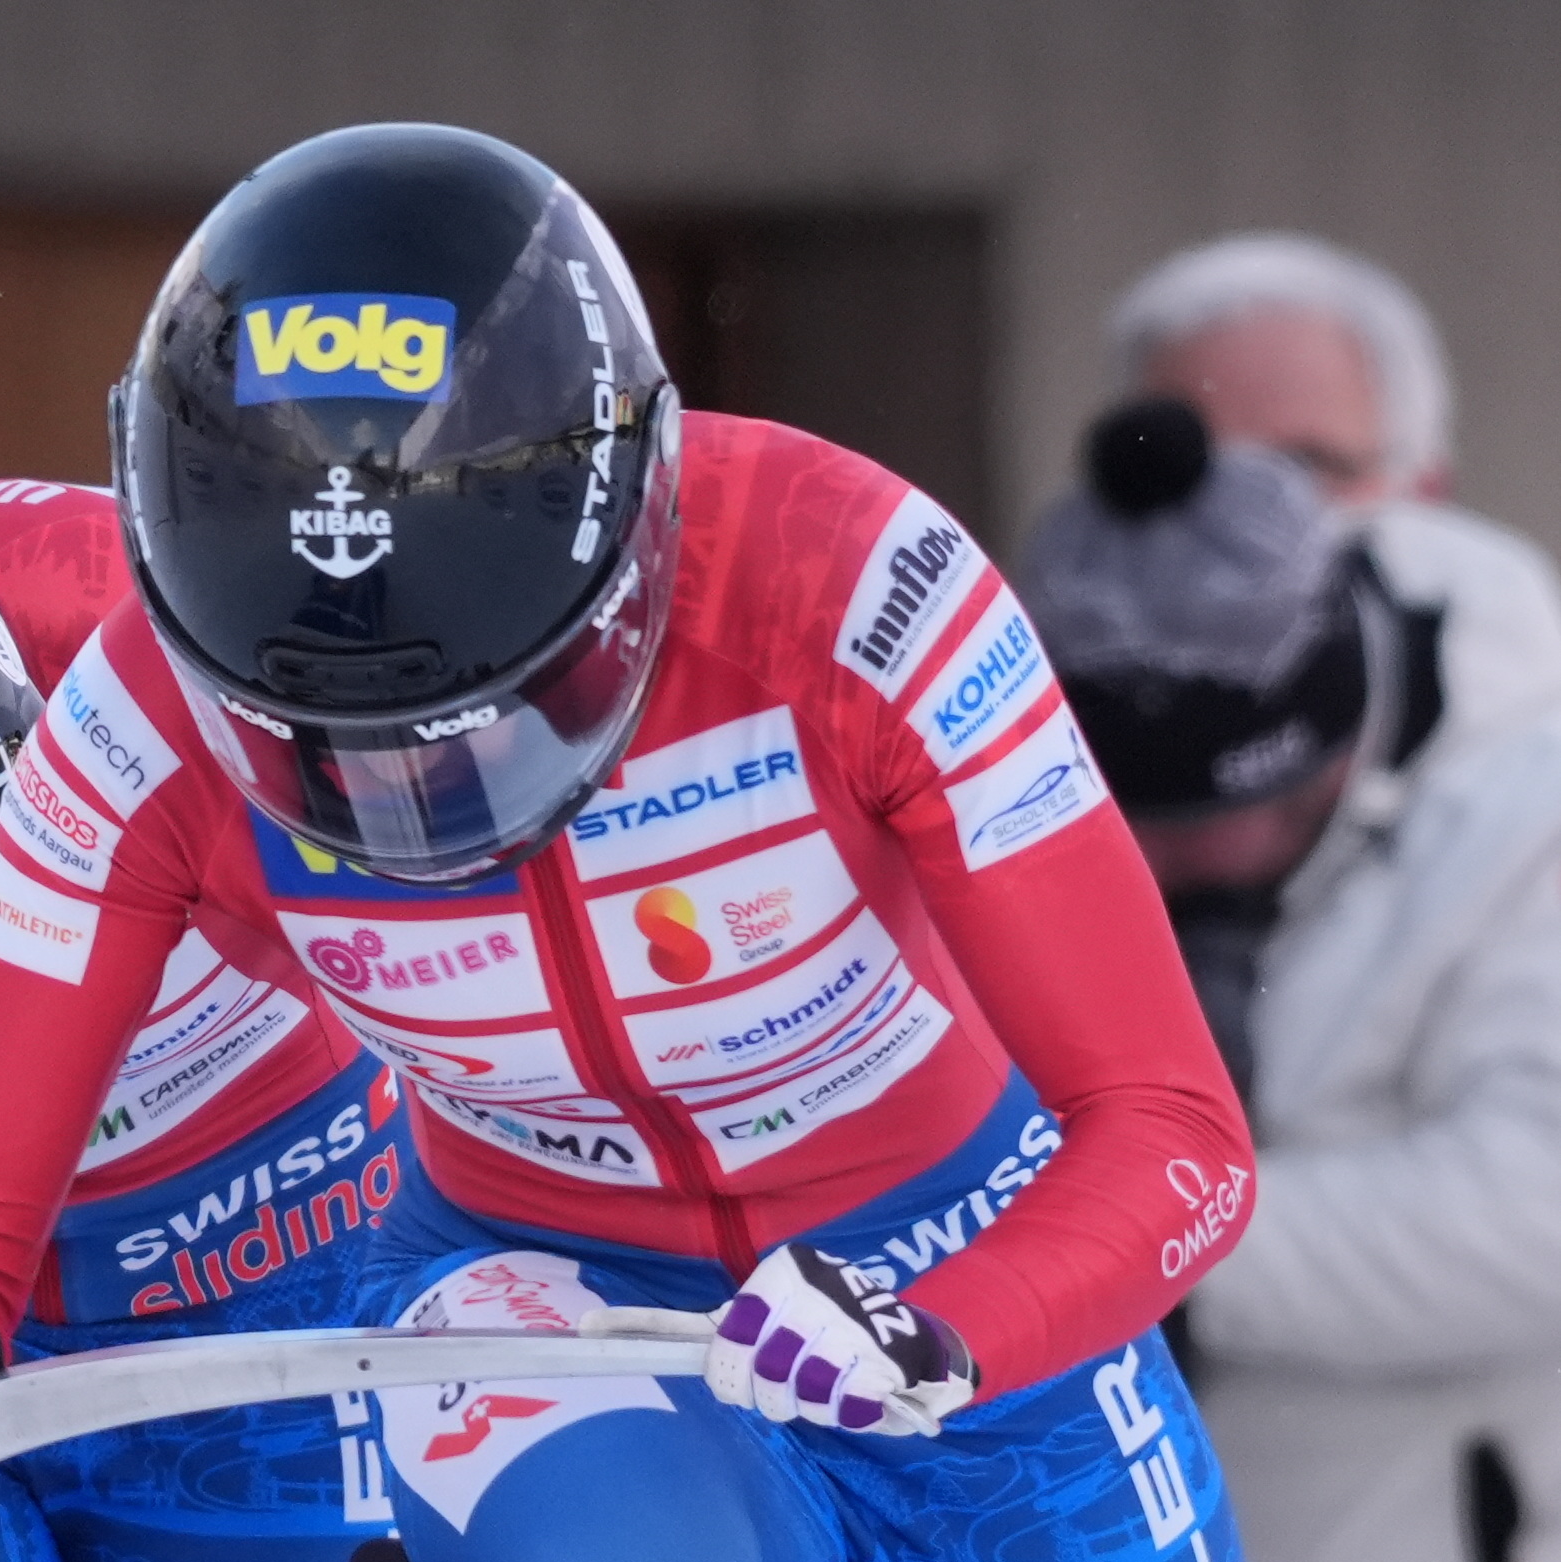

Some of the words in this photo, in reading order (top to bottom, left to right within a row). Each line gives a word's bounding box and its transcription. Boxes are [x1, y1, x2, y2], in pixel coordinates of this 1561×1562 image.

[245, 302, 447, 393] Volg
[570, 258, 616, 564] STADLER
[290, 509, 392, 536] KIBAG
[218, 691, 294, 741] Volg
[933, 613, 1033, 736] KOHLER
[412, 703, 500, 742] Volg
[570, 750, 797, 842] STADLER
[39, 830, 94, 873] Aargau
[719, 885, 793, 925] Swiss
[729, 905, 794, 947] Steel
[738, 937, 785, 963] Group
[376, 930, 520, 992] MEIER
[717, 957, 868, 1053] schmidt
[139, 1010, 282, 1108] CARBOMILL
[115, 1103, 366, 1272] SWISS
[850, 1114, 1064, 1291] SWISS
[1161, 1163, 1249, 1279] OMEGA
